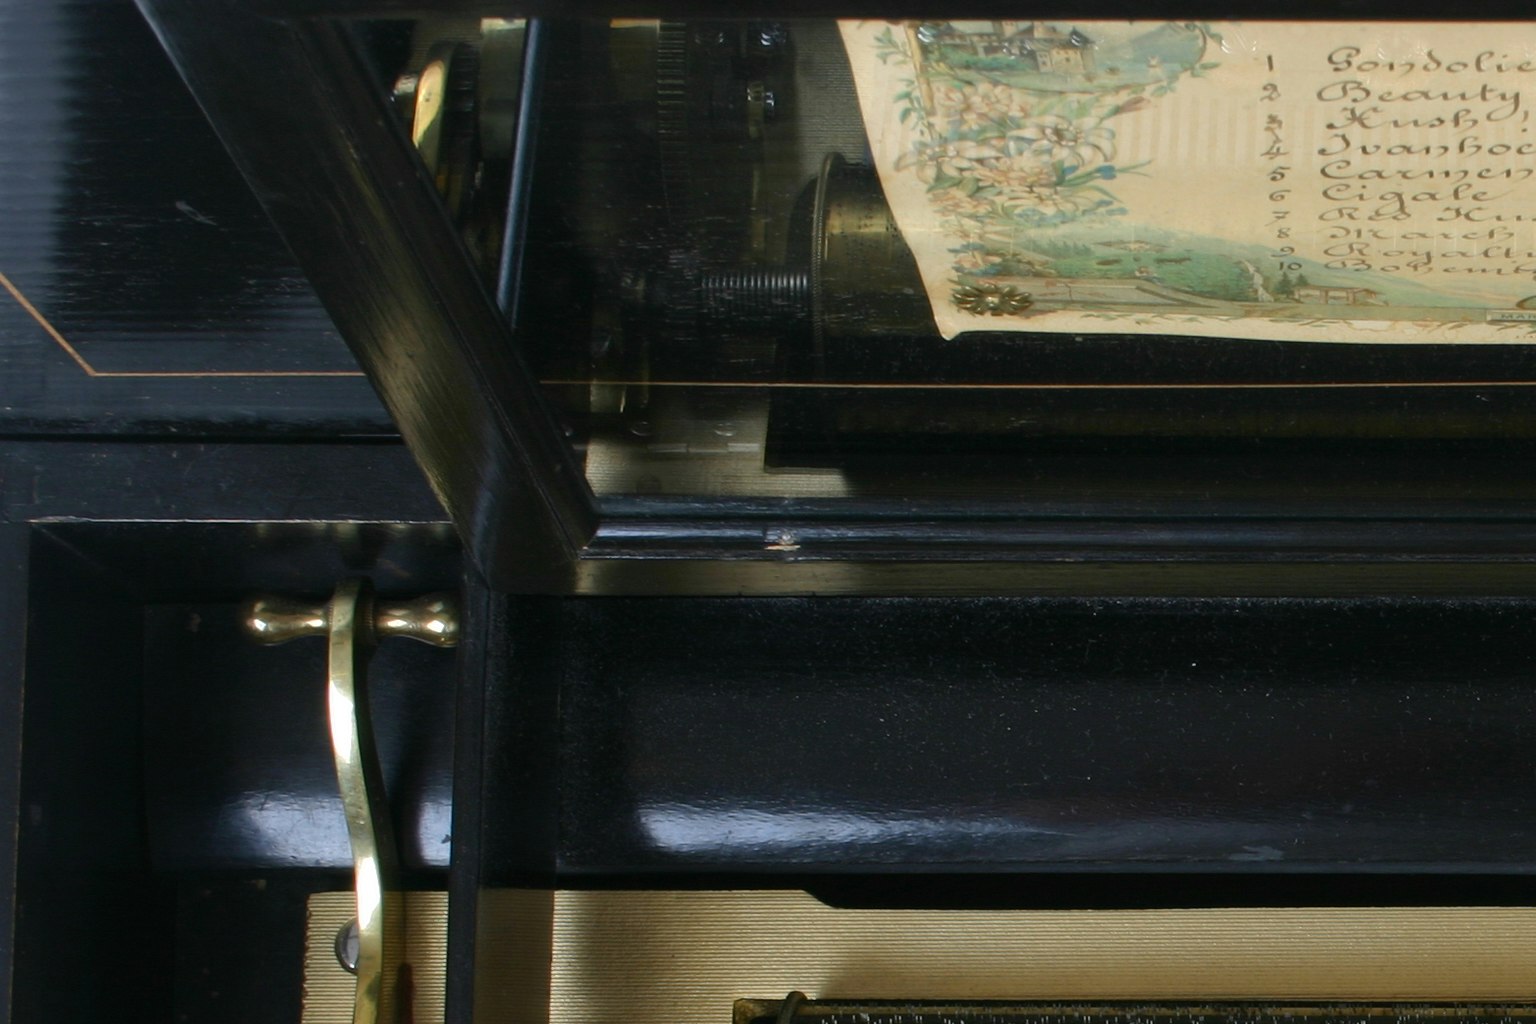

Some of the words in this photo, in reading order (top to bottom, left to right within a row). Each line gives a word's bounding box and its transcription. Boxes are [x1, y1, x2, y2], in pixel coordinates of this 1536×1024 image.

[1266, 54, 1275, 73] 1
[1260, 83, 1282, 102] 2
[1317, 80, 1521, 122] Beauty
[1267, 166, 1291, 182] 5
[1320, 160, 1534, 182] Carmen
[1268, 189, 1292, 202] 6
[1321, 183, 1505, 217] Cigale
[1265, 210, 1291, 227] 7
[1276, 227, 1292, 239] 8
[1320, 226, 1515, 242] March
[1271, 246, 1296, 258] 9
[1278, 261, 1303, 273] 10
